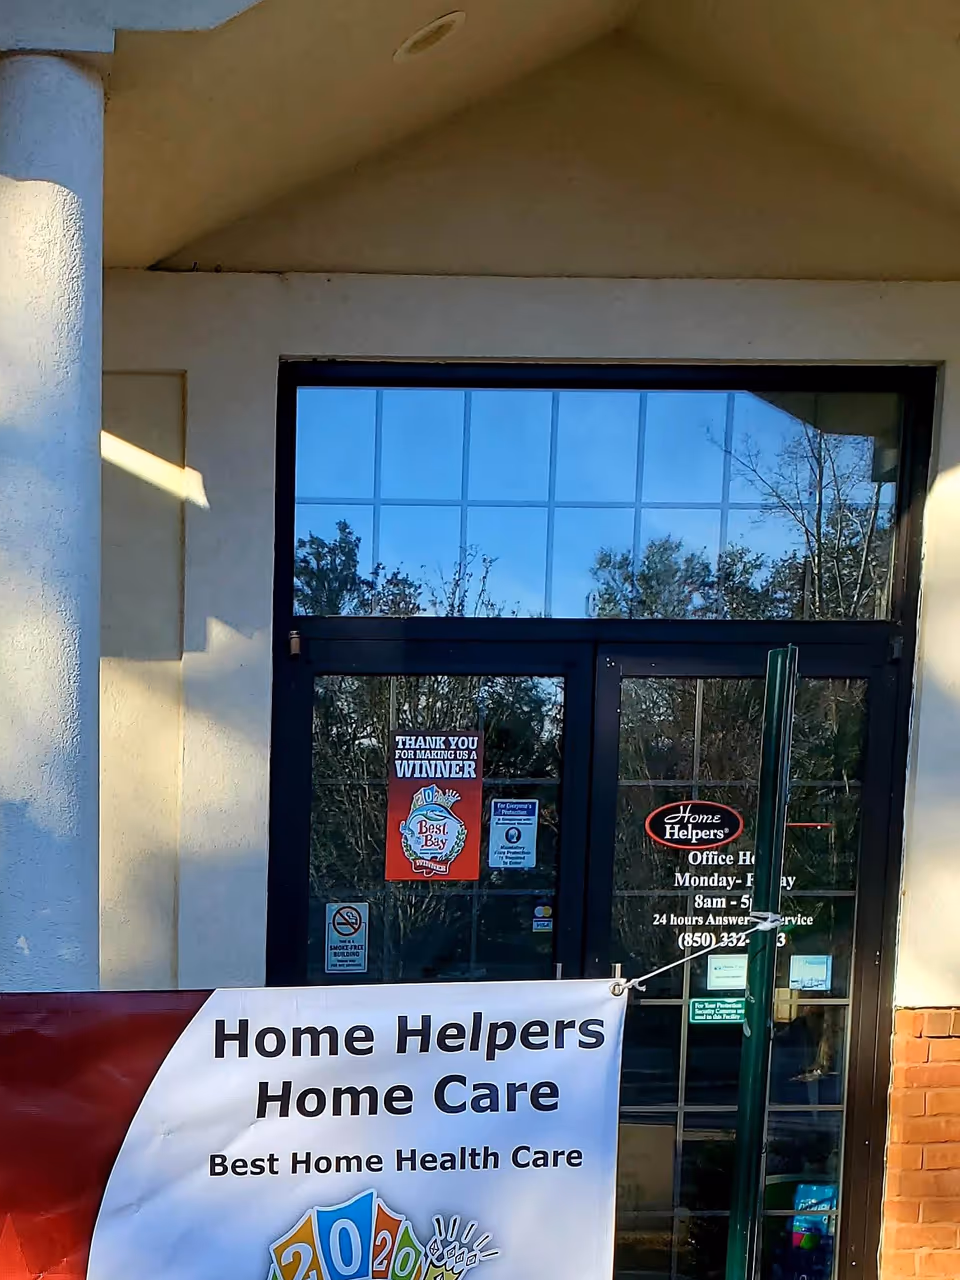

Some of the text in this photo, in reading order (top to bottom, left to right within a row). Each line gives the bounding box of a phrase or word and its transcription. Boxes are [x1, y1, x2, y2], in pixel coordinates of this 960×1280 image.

[395, 735, 479, 750] THANK YOU
[394, 749, 477, 759] FOR MAKING US A
[394, 760, 477, 778] WINNER
[664, 803, 721, 823] Home
[417, 819, 449, 836] Best
[421, 834, 448, 850] Bay
[688, 851, 734, 865] Office
[673, 873, 742, 890] Monday-
[694, 894, 726, 908] 8am
[652, 914, 667, 925] 24
[670, 914, 703, 925] hours
[780, 914, 814, 925] ervice
[678, 931, 716, 949] (850)
[214, 1012, 606, 1061] Home Helpers
[255, 1074, 560, 1119] Home Care
[209, 1145, 583, 1177] Best Home Health Care
